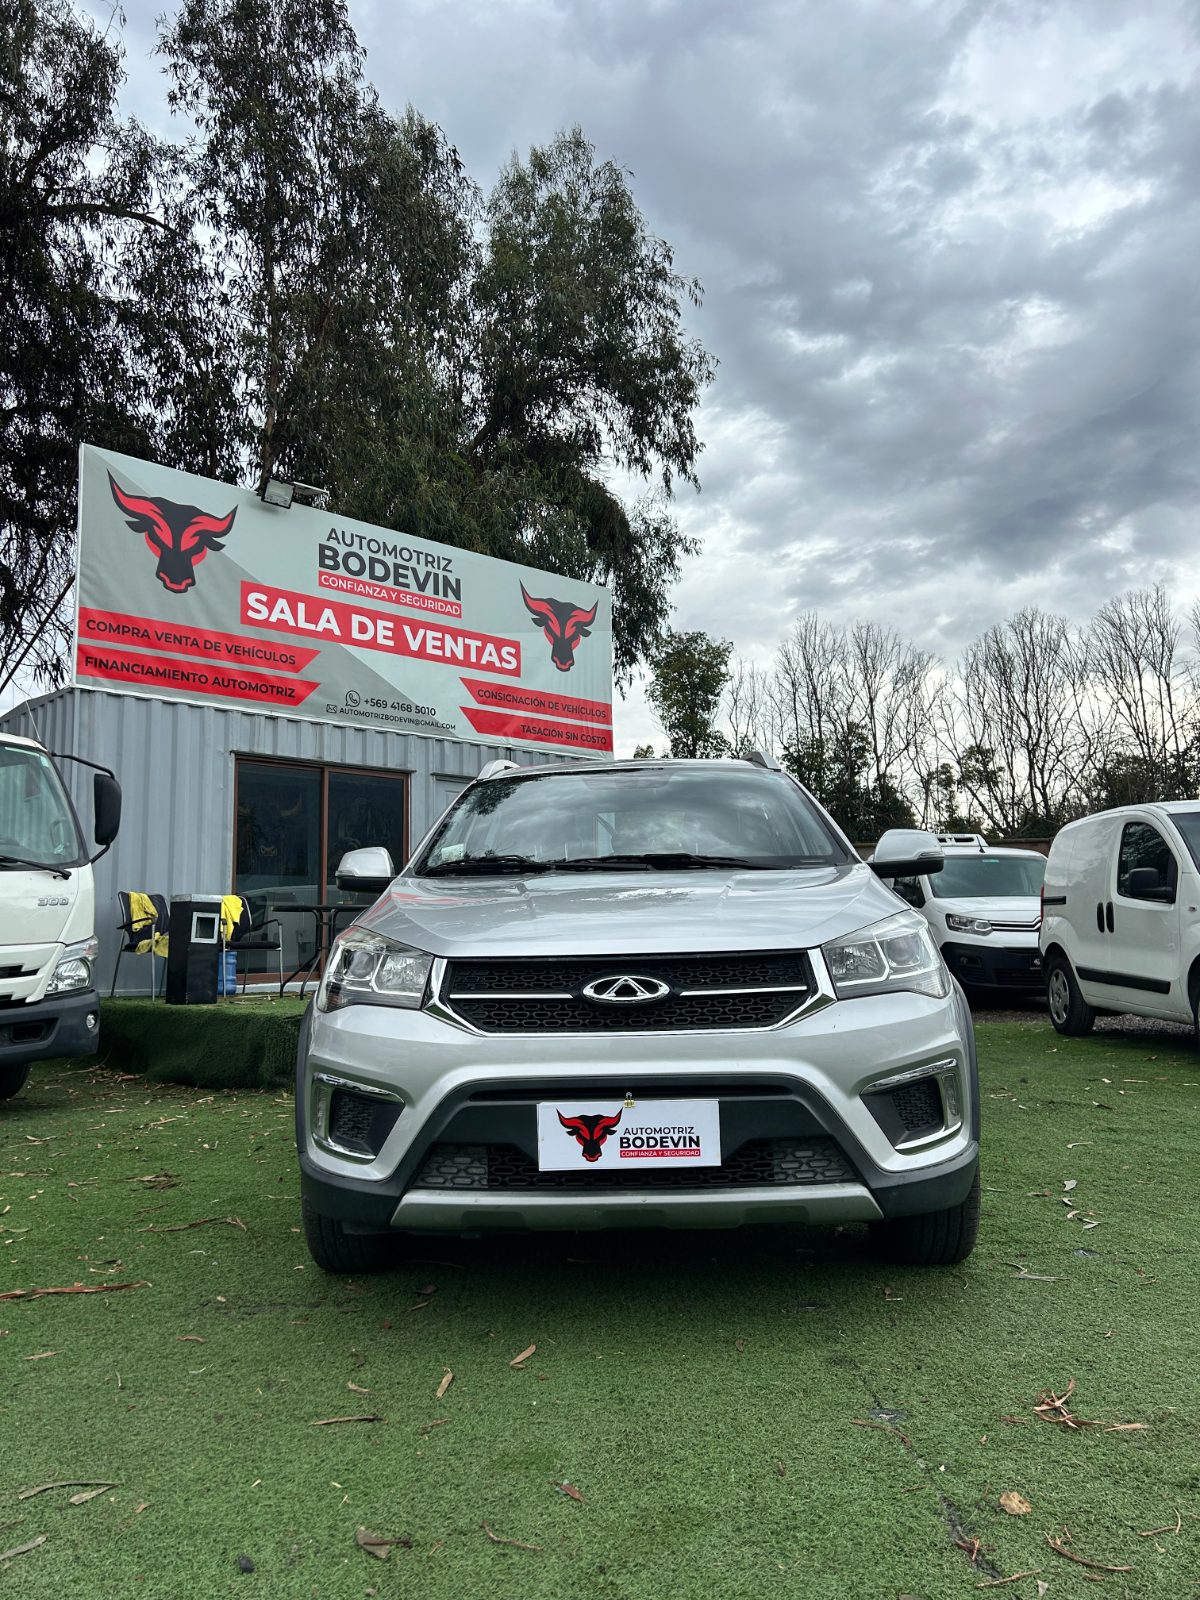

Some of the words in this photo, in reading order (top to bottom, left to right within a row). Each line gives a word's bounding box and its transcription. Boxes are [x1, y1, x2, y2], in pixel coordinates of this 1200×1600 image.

[326, 527, 453, 573] AUTOMOTRIZ
[318, 543, 461, 601] BODEVIN
[321, 575, 388, 599] CONFIANZA
[389, 590, 398, 601] Y
[400, 593, 460, 615] SEGURIDAD
[86, 619, 151, 640] COMPRA
[154, 631, 200, 649] VENTA
[203, 639, 222, 653] DE
[225, 644, 296, 665] VEHÍCULOS
[247, 591, 341, 636] SALA
[351, 617, 395, 647] DE
[402, 624, 518, 670] VENTAS
[85, 655, 209, 685] FINANCIAMIENTO
[211, 675, 296, 698] AUTOMOTRIZ
[364, 698, 388, 709] +569
[390, 701, 413, 713] 4168
[414, 705, 437, 716] 5010
[477, 688, 546, 708] CONSIGNACIÓN
[547, 701, 560, 710] DE
[561, 703, 607, 718] VEHÍCULOS
[339, 707, 456, 730] AUTOMOTRIZBODEVIN@GMAIL.COM
[520, 724, 564, 739] TASACIÓN
[565, 732, 579, 741] SIN
[580, 733, 607, 745] COSTO
[37, 897, 70, 907] 300
[619, 1135, 700, 1149] BODEVIN
[623, 1126, 695, 1136] AUTOMOTRIZ
